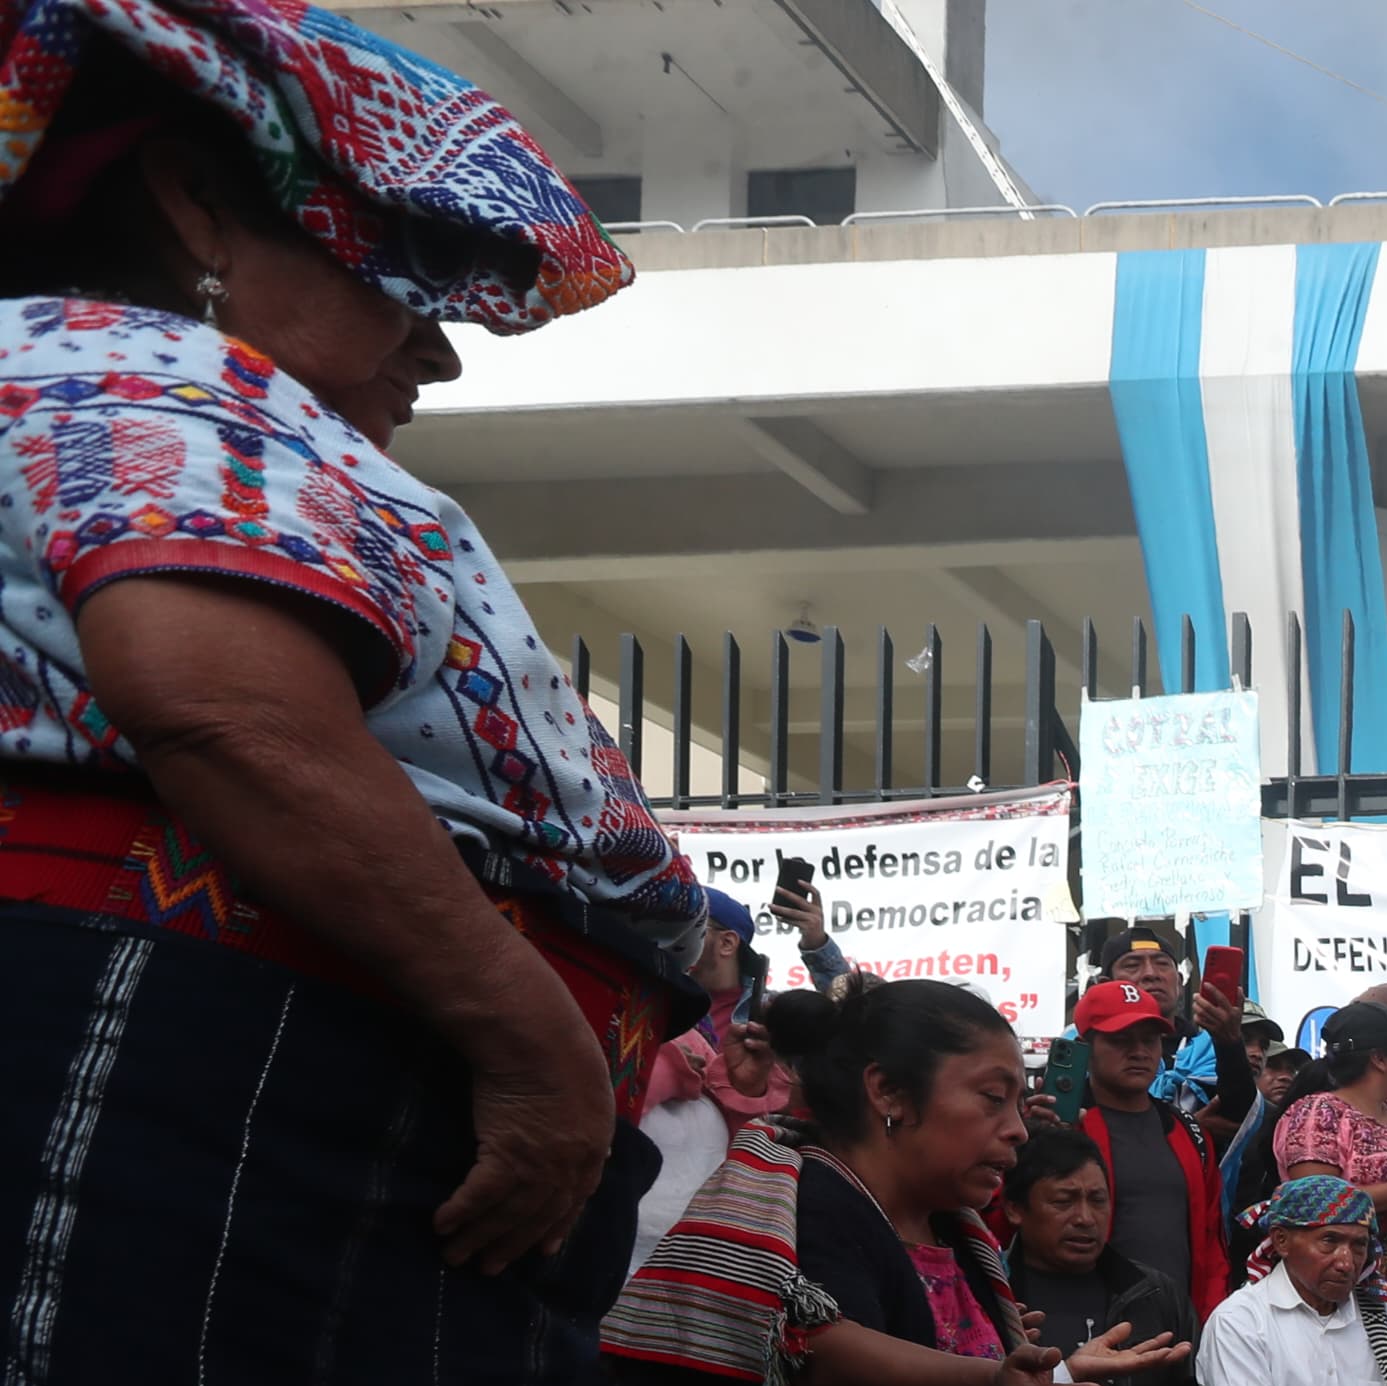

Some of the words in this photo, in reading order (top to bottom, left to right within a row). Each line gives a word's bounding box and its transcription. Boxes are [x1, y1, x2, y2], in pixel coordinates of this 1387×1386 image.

[706, 851, 765, 885] Por
[821, 844, 963, 881] defensa
[975, 839, 1017, 871] de
[1028, 836, 1060, 868] la
[1288, 836, 1374, 908] EL
[830, 889, 1043, 934] Democracia
[843, 948, 1012, 983] evanten,
[1119, 984, 1141, 1003] B
